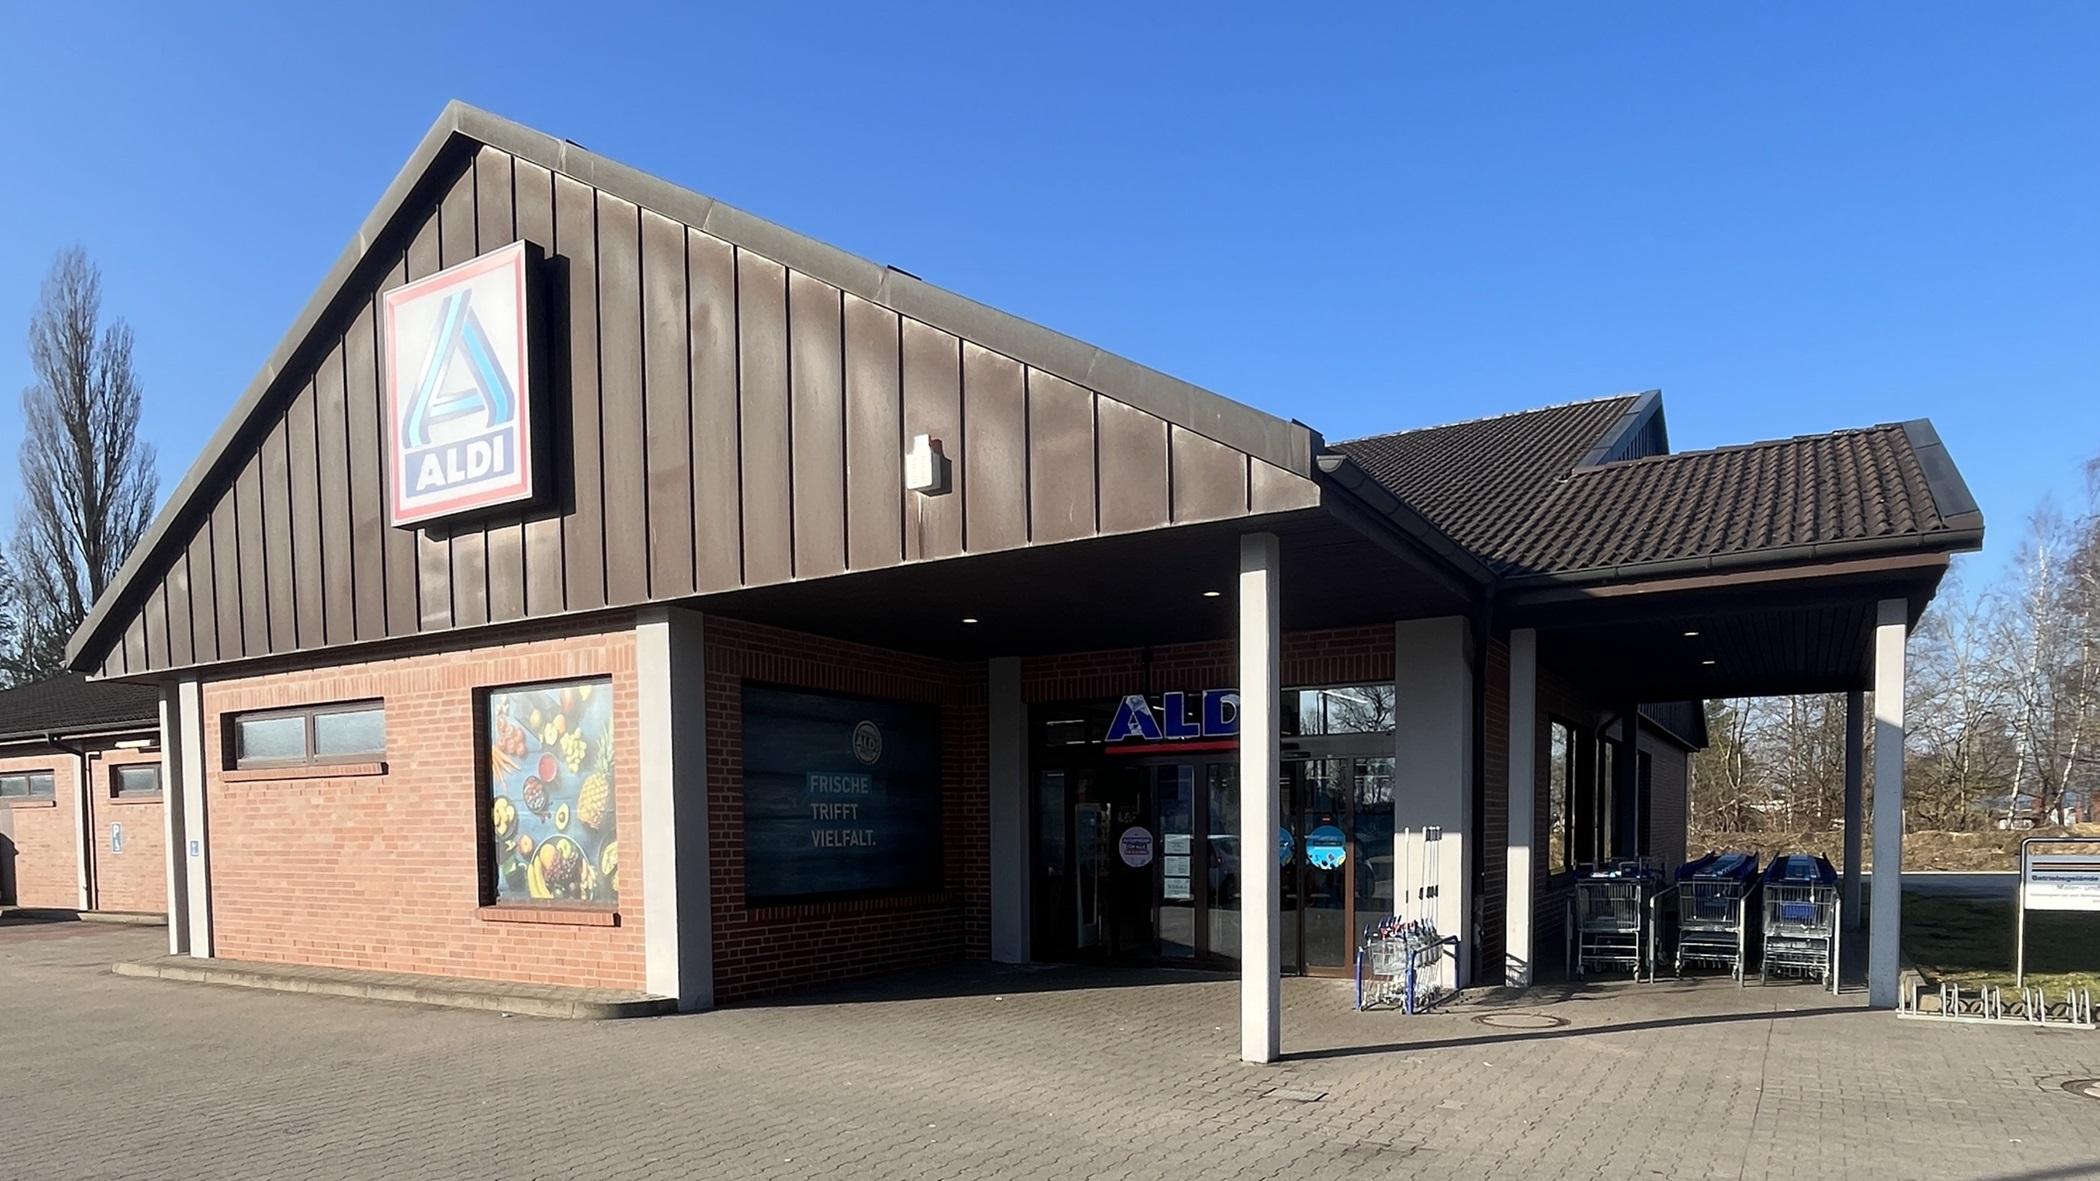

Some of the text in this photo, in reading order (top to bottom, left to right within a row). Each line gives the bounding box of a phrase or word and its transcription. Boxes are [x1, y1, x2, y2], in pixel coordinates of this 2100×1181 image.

[416, 435, 504, 491] ALDI
[1105, 688, 1240, 743] ALD
[810, 775, 869, 794] FRISCHE
[810, 802, 858, 820] TRIFFT
[811, 828, 877, 848] VIELFALT.
